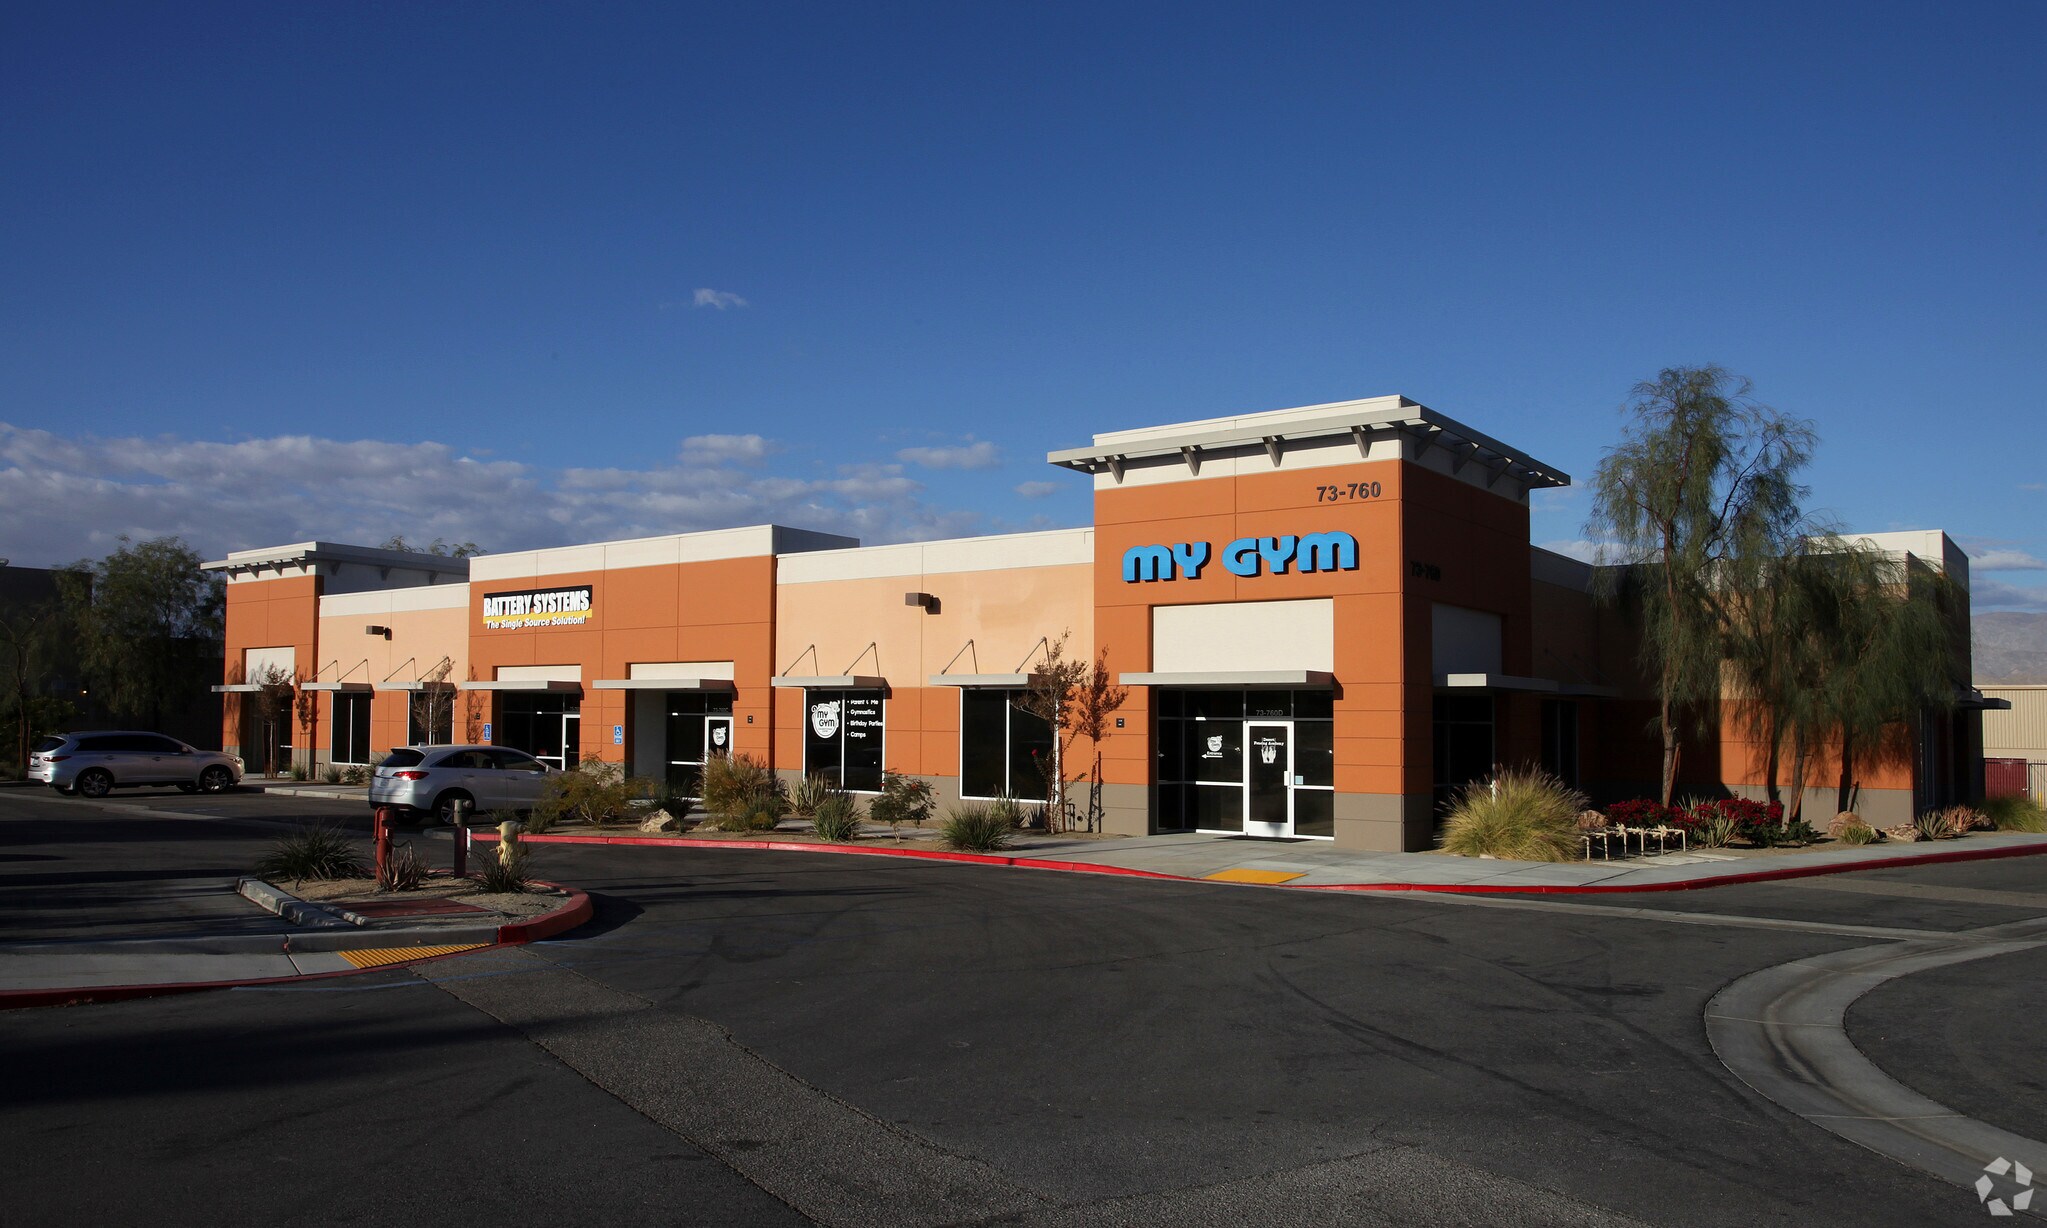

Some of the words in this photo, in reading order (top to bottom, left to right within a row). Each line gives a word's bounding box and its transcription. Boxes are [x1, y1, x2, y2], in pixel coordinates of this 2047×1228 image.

[1316, 481, 1382, 502] 73-760
[1122, 541, 1211, 583] MY
[1222, 530, 1359, 577] GYM
[484, 594, 532, 617] BATTERY
[533, 590, 590, 614] SYSTEMS
[487, 620, 500, 629] The
[501, 619, 523, 630] Single
[524, 617, 550, 627] Source
[818, 719, 835, 727] GYM
[850, 731, 866, 739] Camps
